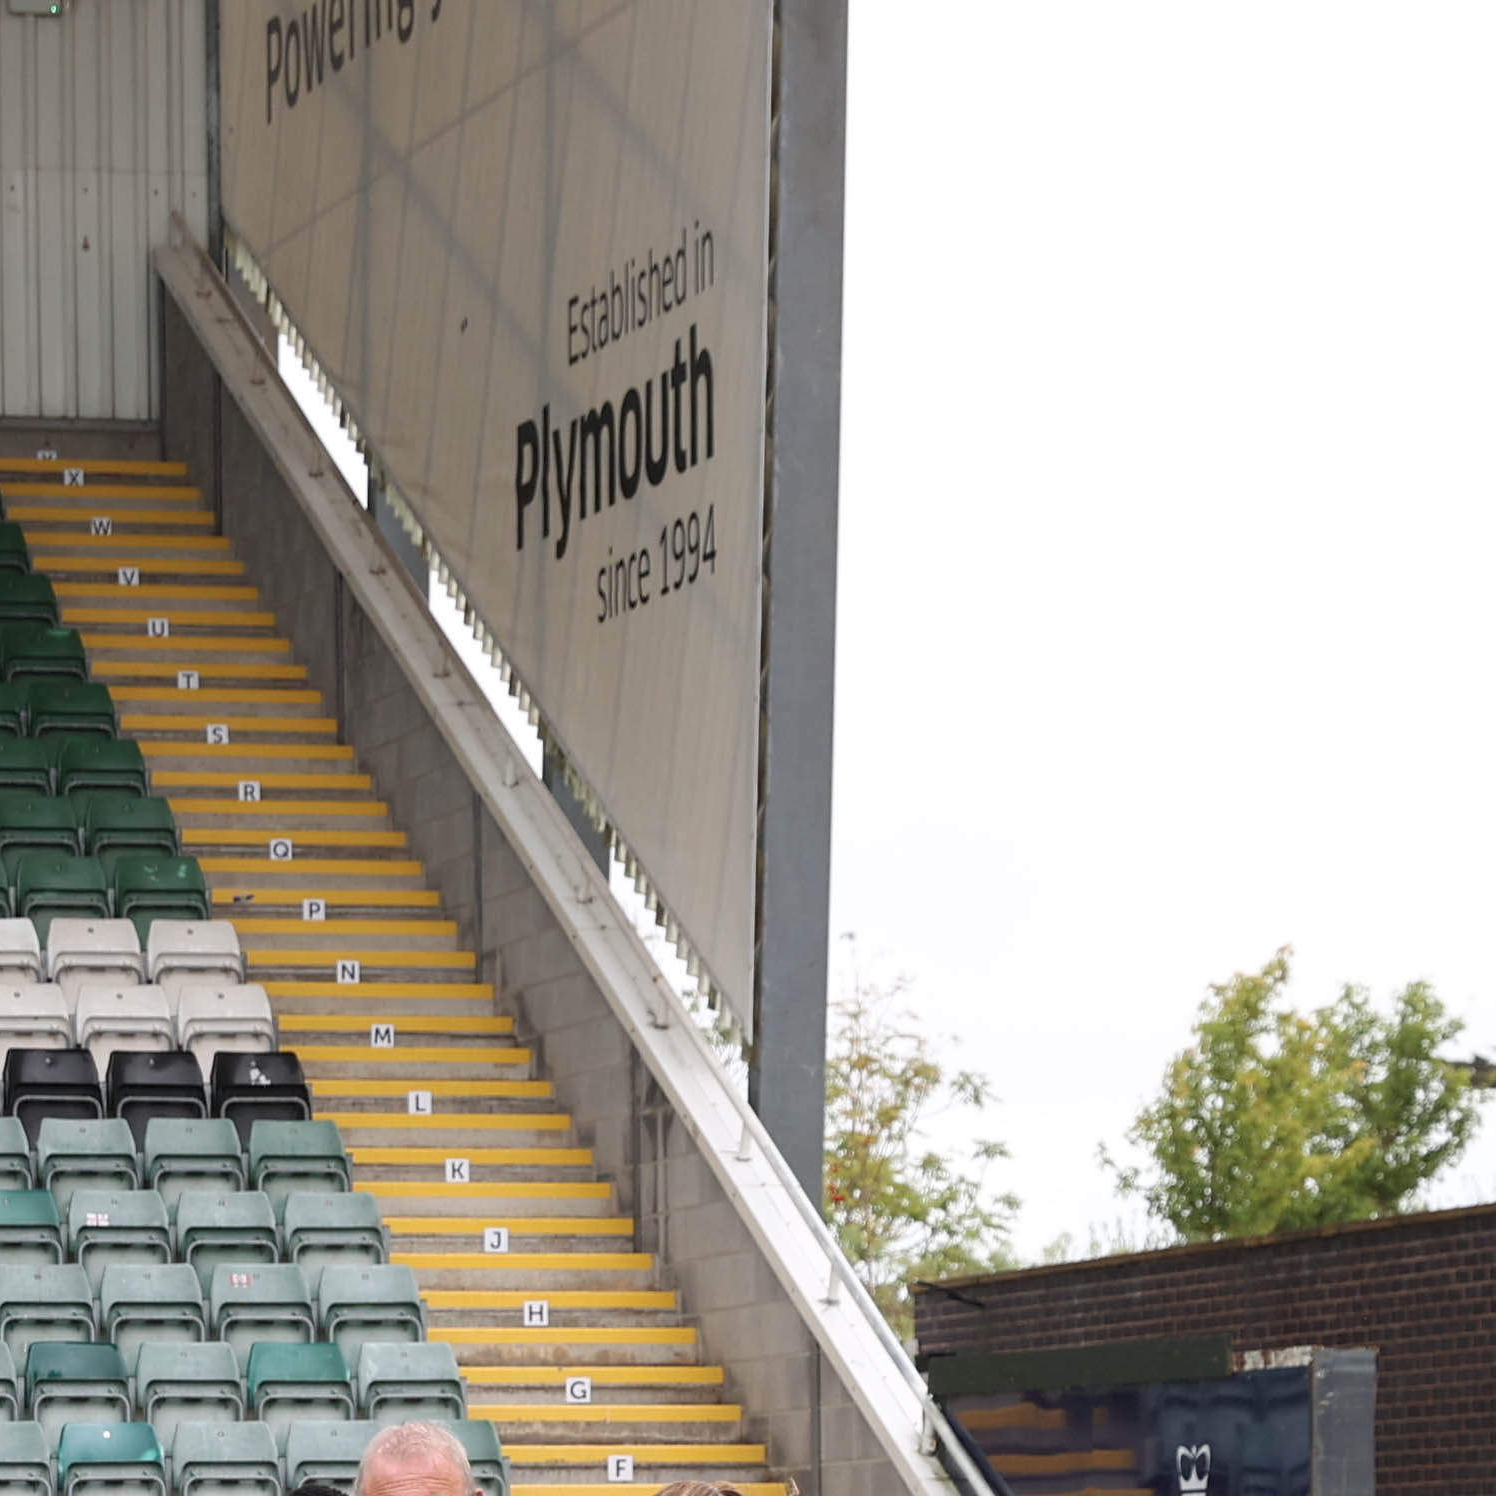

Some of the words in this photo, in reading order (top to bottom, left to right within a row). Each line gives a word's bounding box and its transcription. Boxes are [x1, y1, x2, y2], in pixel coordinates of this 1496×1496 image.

[568, 229, 688, 366] Established
[694, 219, 715, 289] in
[516, 323, 716, 560] Plymouth
[597, 547, 651, 624] since
[659, 503, 718, 597] 1994
[273, 842, 290, 860] Q
[308, 902, 321, 919] P
[341, 964, 356, 981] N
[374, 1027, 392, 1044] M
[414, 1095, 426, 1112] L
[451, 1163, 465, 1179] K
[490, 1232, 502, 1250] J
[529, 1305, 544, 1322] H
[569, 1380, 587, 1400] G
[615, 1459, 627, 1478] F
